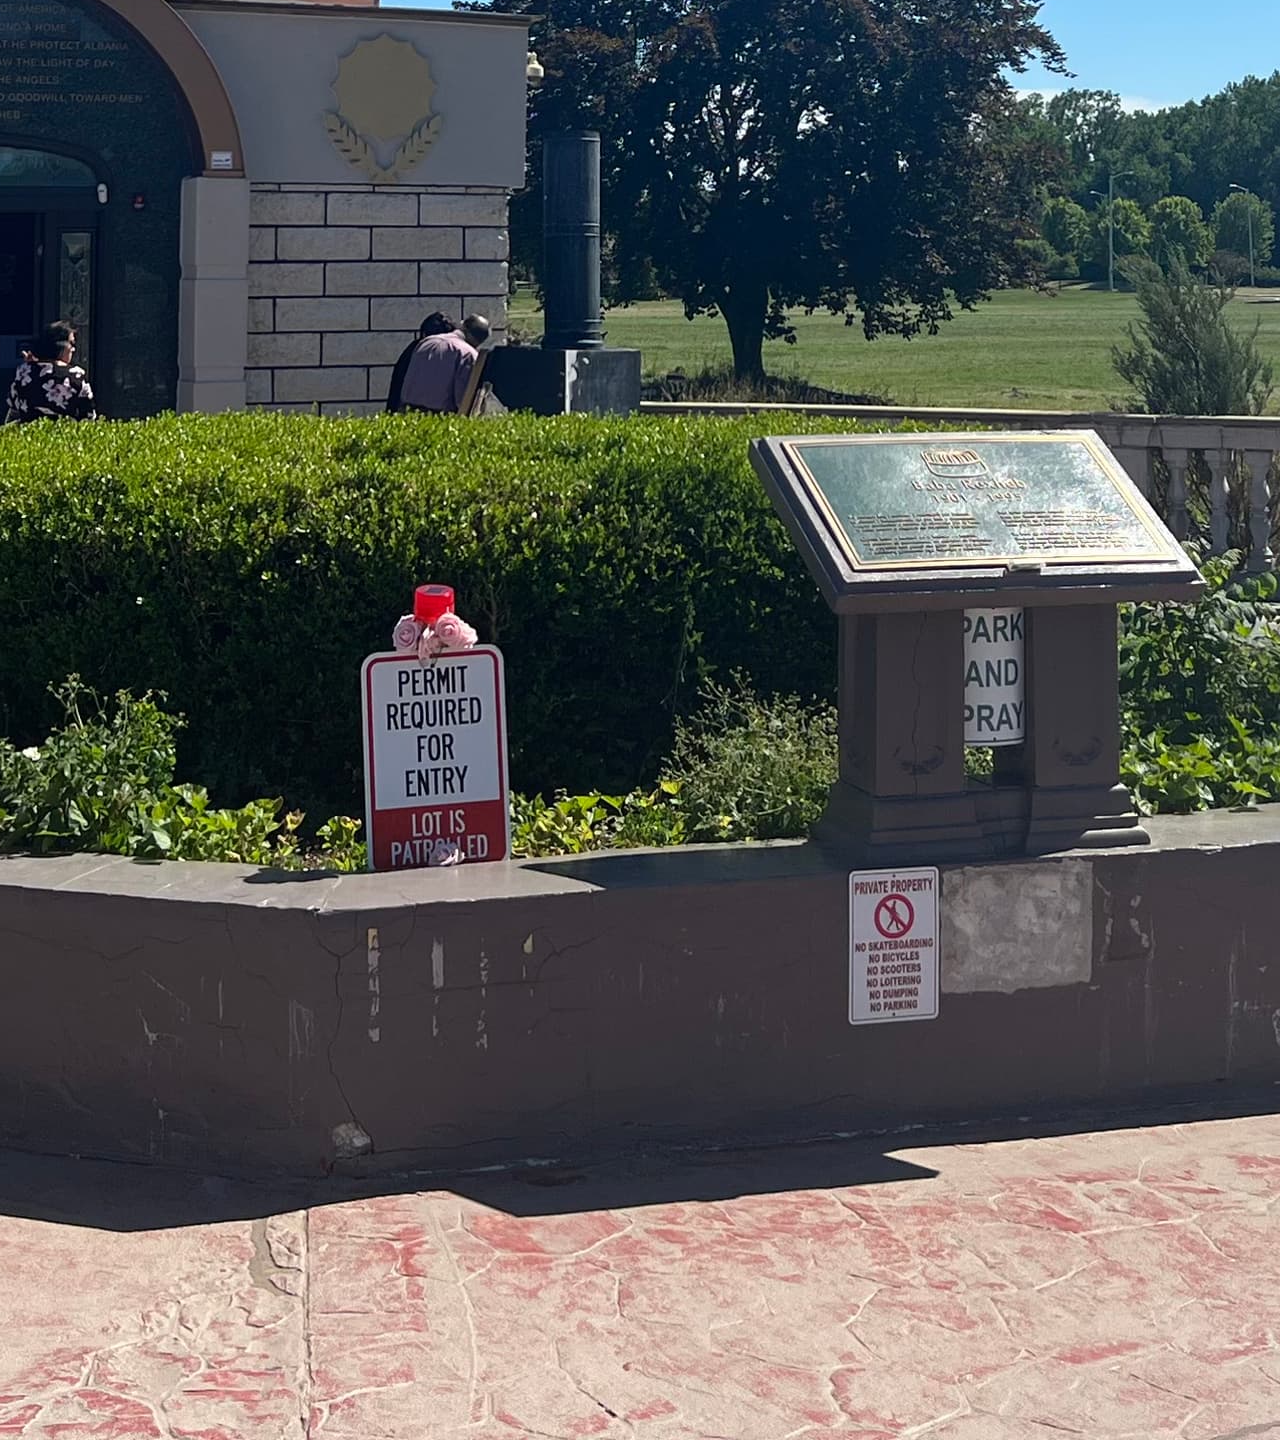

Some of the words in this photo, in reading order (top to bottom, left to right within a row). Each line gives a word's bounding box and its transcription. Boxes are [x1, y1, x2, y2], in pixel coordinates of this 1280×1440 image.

[19, 4, 65, 14] AMERICA
[35, 23, 66, 32] HOME
[11, 40, 27, 49] HE
[31, 40, 80, 50] PROTECT
[84, 41, 128, 50] ALBANIA
[16, 58, 39, 67] THE
[41, 58, 72, 68] LIGHT
[76, 59, 90, 68] OF
[94, 59, 115, 69] DAY
[15, 75, 59, 85] ANGELS
[7, 92, 64, 103] GOODWILL
[69, 93, 116, 103] TOWARD
[911, 479, 956, 492] Baba
[961, 478, 1025, 490] Rexheb
[963, 612, 1023, 643] PARK
[965, 658, 1019, 688] AND
[398, 665, 468, 698] PERMIT
[386, 696, 482, 731] REQUIRED
[963, 701, 1024, 732] PRAY
[417, 733, 454, 763] FOR
[405, 765, 468, 798] ENTRY
[412, 811, 442, 837] LOT
[449, 809, 465, 834] IS
[391, 834, 488, 866] PATRED
[854, 880, 889, 895] PRIVATE
[890, 877, 934, 893] PROPERTY
[855, 942, 867, 952] NO
[868, 938, 934, 952] SKATEBOARDING
[868, 953, 880, 964] NO
[882, 951, 920, 963] BICYCLES
[867, 966, 878, 976] NO
[880, 963, 921, 975] SCOOTERS
[866, 978, 878, 989] NO
[880, 975, 922, 987] LOITERING
[869, 990, 881, 1000] NO
[882, 987, 919, 999] DUMPING
[870, 1003, 882, 1012] NO
[883, 1000, 918, 1011] PARKING
